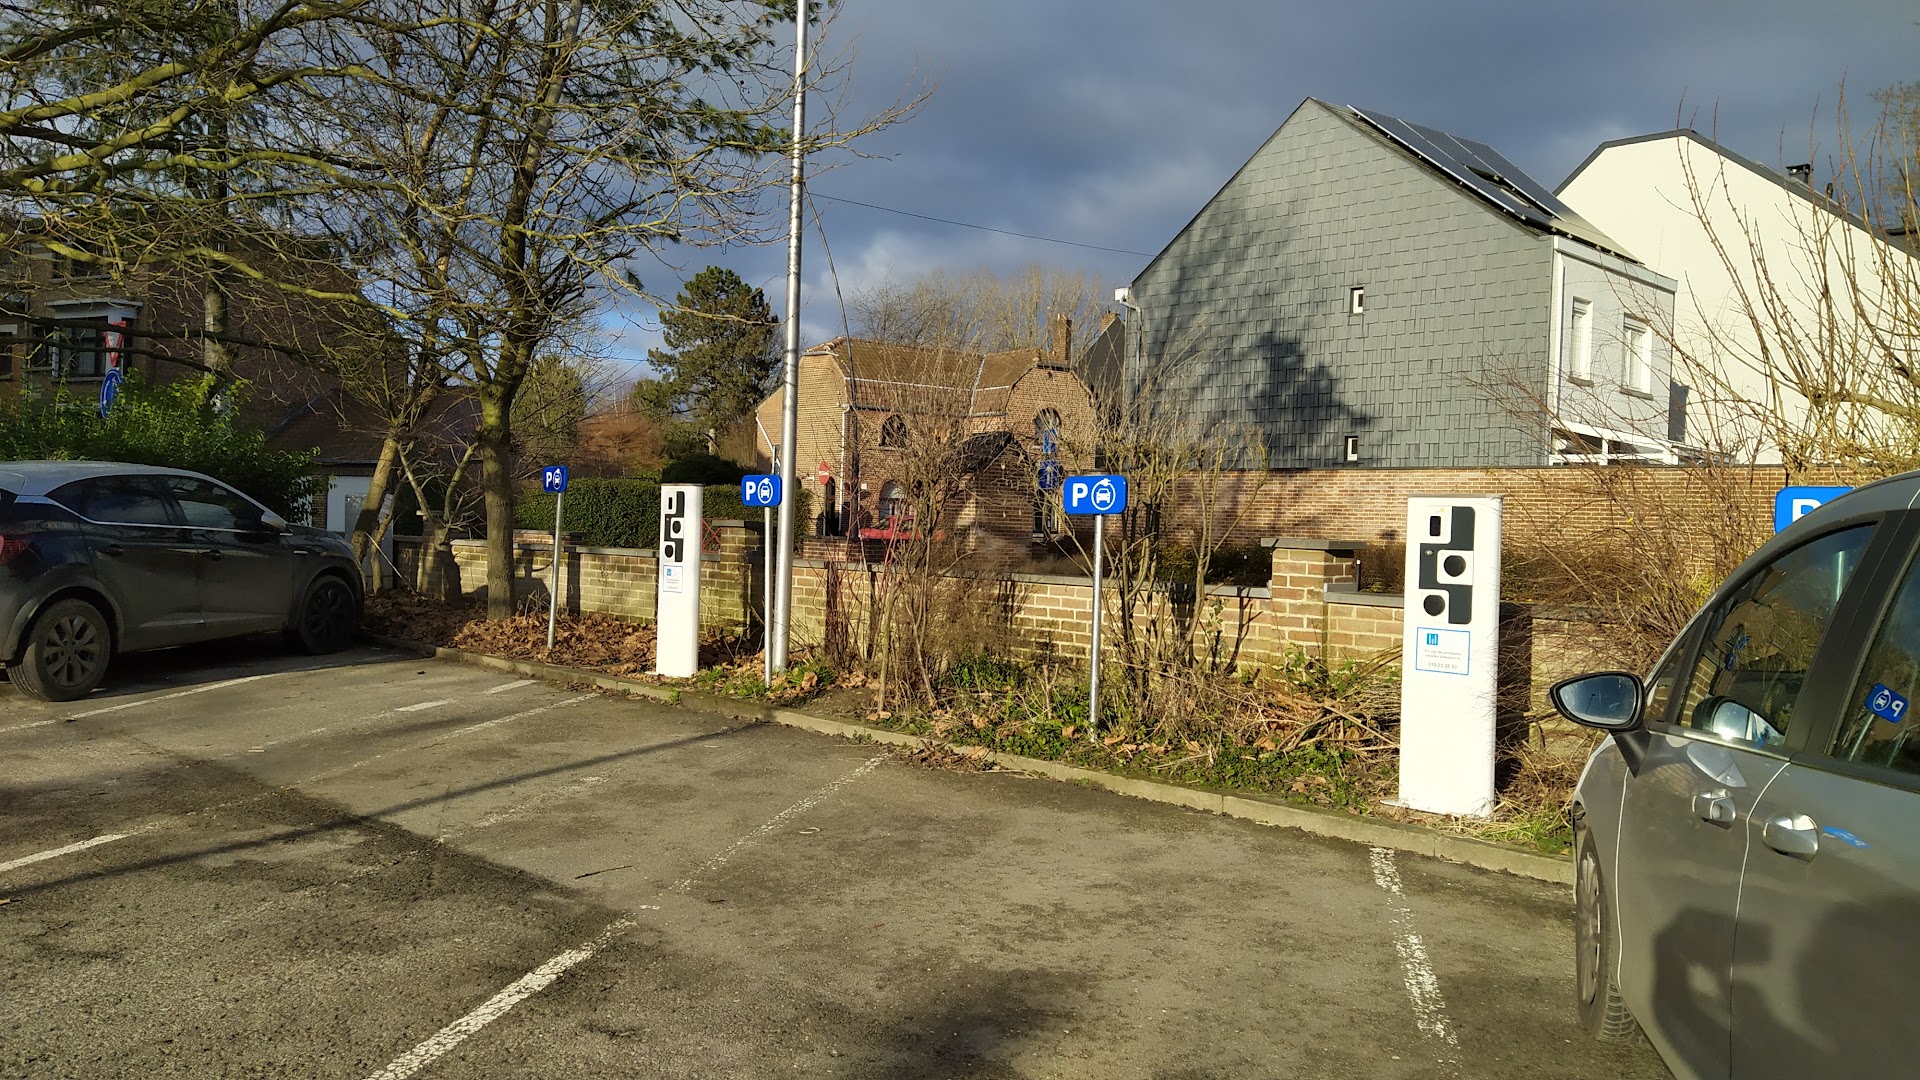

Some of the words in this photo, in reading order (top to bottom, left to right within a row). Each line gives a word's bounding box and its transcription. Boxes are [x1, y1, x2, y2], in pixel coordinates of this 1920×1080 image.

[546, 471, 552, 488] P
[745, 481, 756, 501] P
[1072, 483, 1088, 507] P
